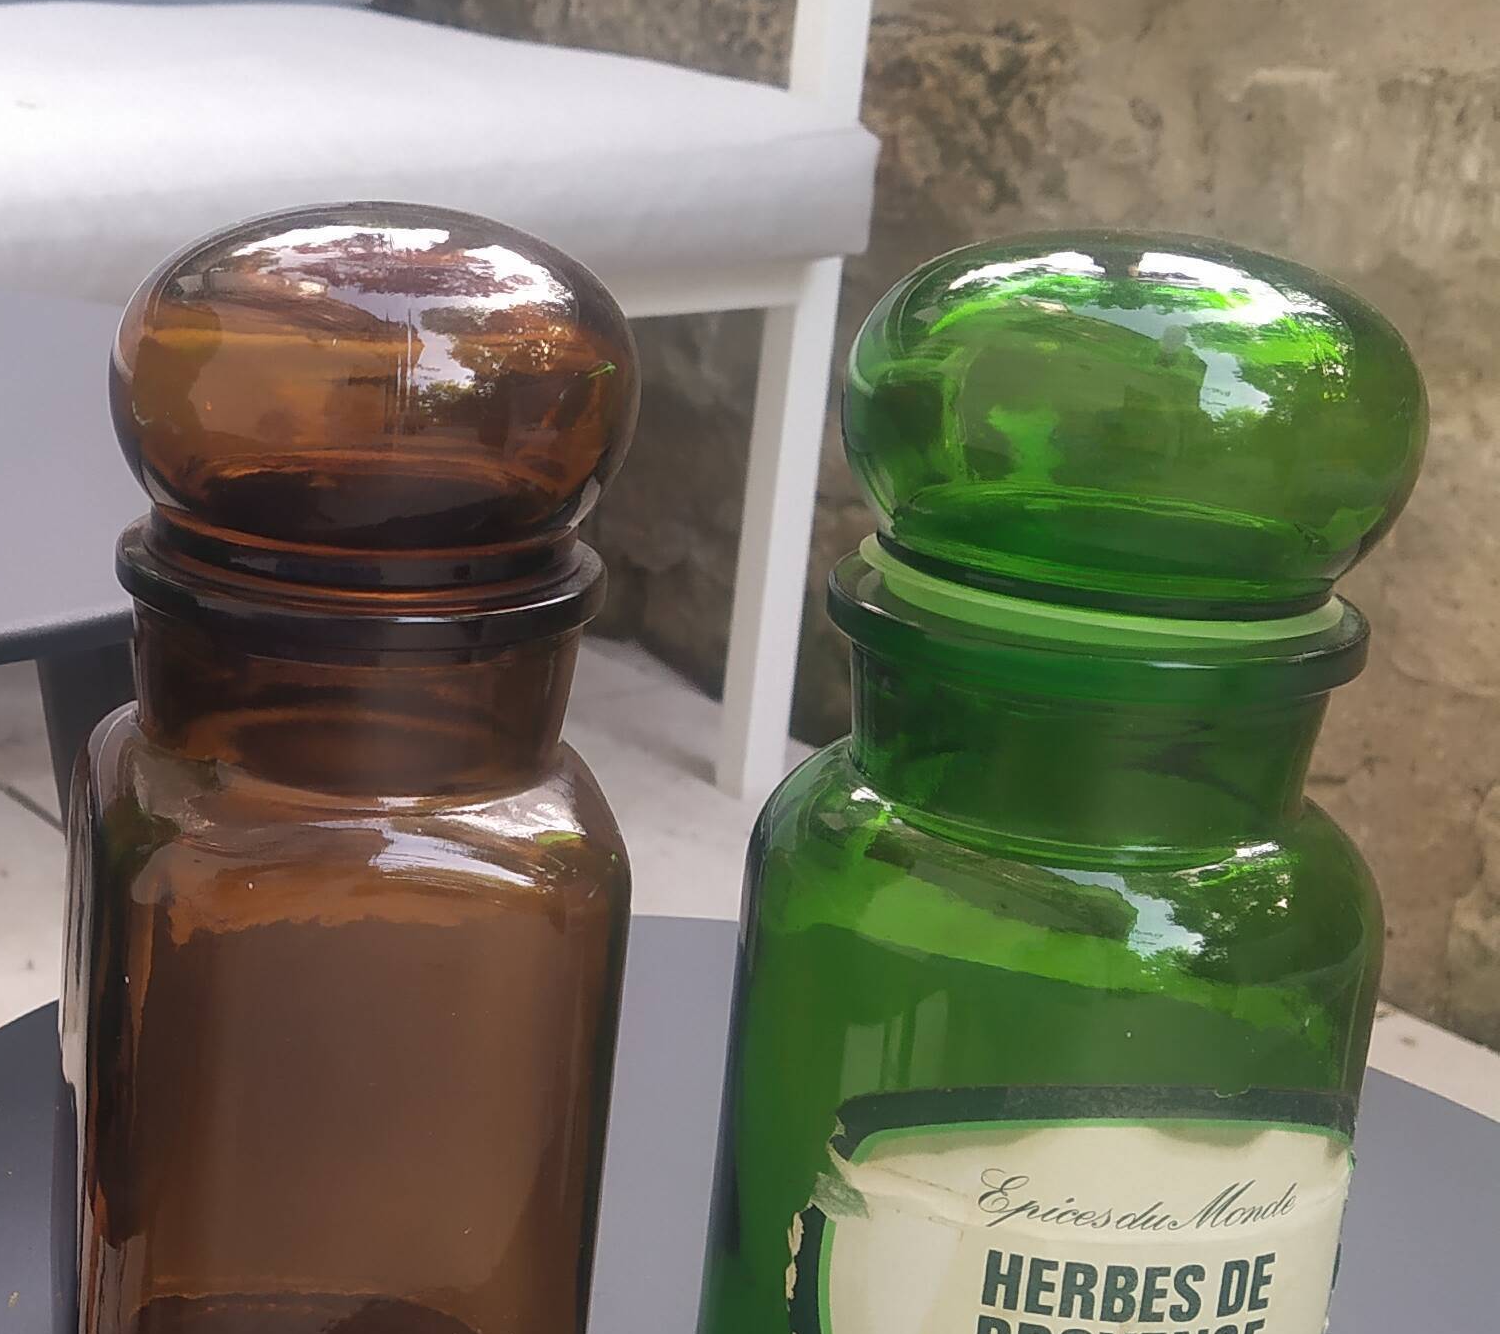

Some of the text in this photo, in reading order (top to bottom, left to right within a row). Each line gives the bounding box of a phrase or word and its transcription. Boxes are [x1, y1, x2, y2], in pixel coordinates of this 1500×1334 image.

[1168, 1179, 1298, 1230] Monde
[981, 1249, 1276, 1322] HERBES DE
